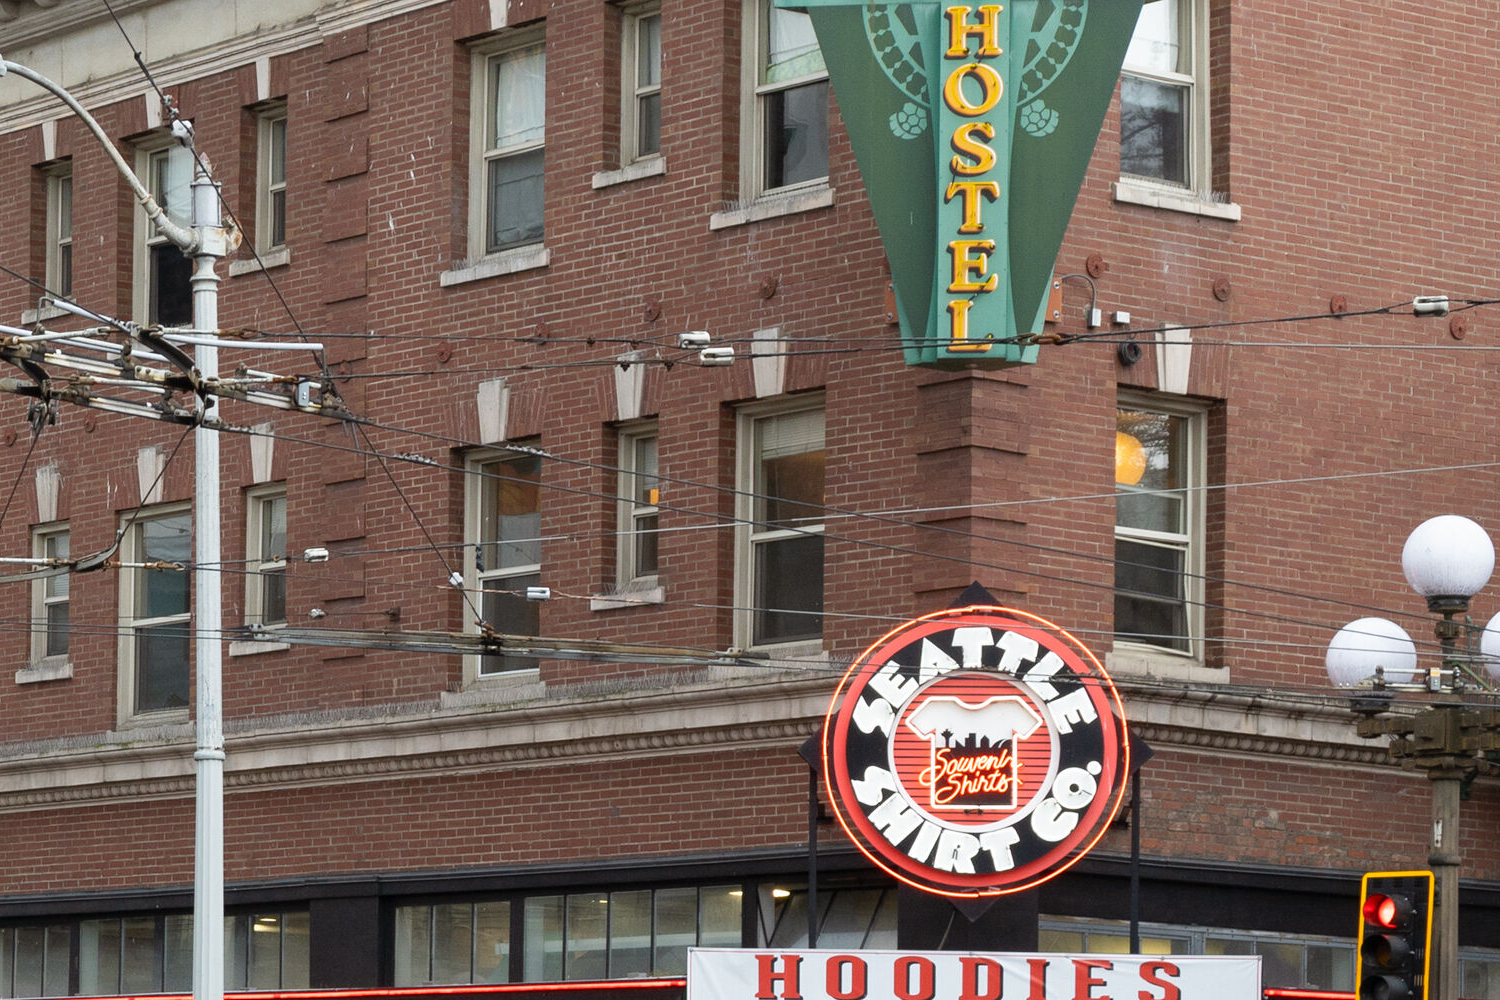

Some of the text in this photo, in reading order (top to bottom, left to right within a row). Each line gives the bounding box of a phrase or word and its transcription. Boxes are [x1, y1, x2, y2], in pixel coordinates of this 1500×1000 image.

[944, 5, 1004, 352] HOSTEL
[852, 627, 1098, 737] SEATTLE
[920, 747, 1023, 786] Souvenir
[934, 772, 1023, 803] Shirts
[1031, 760, 1102, 842] CO.
[851, 766, 1020, 874] SHIRT
